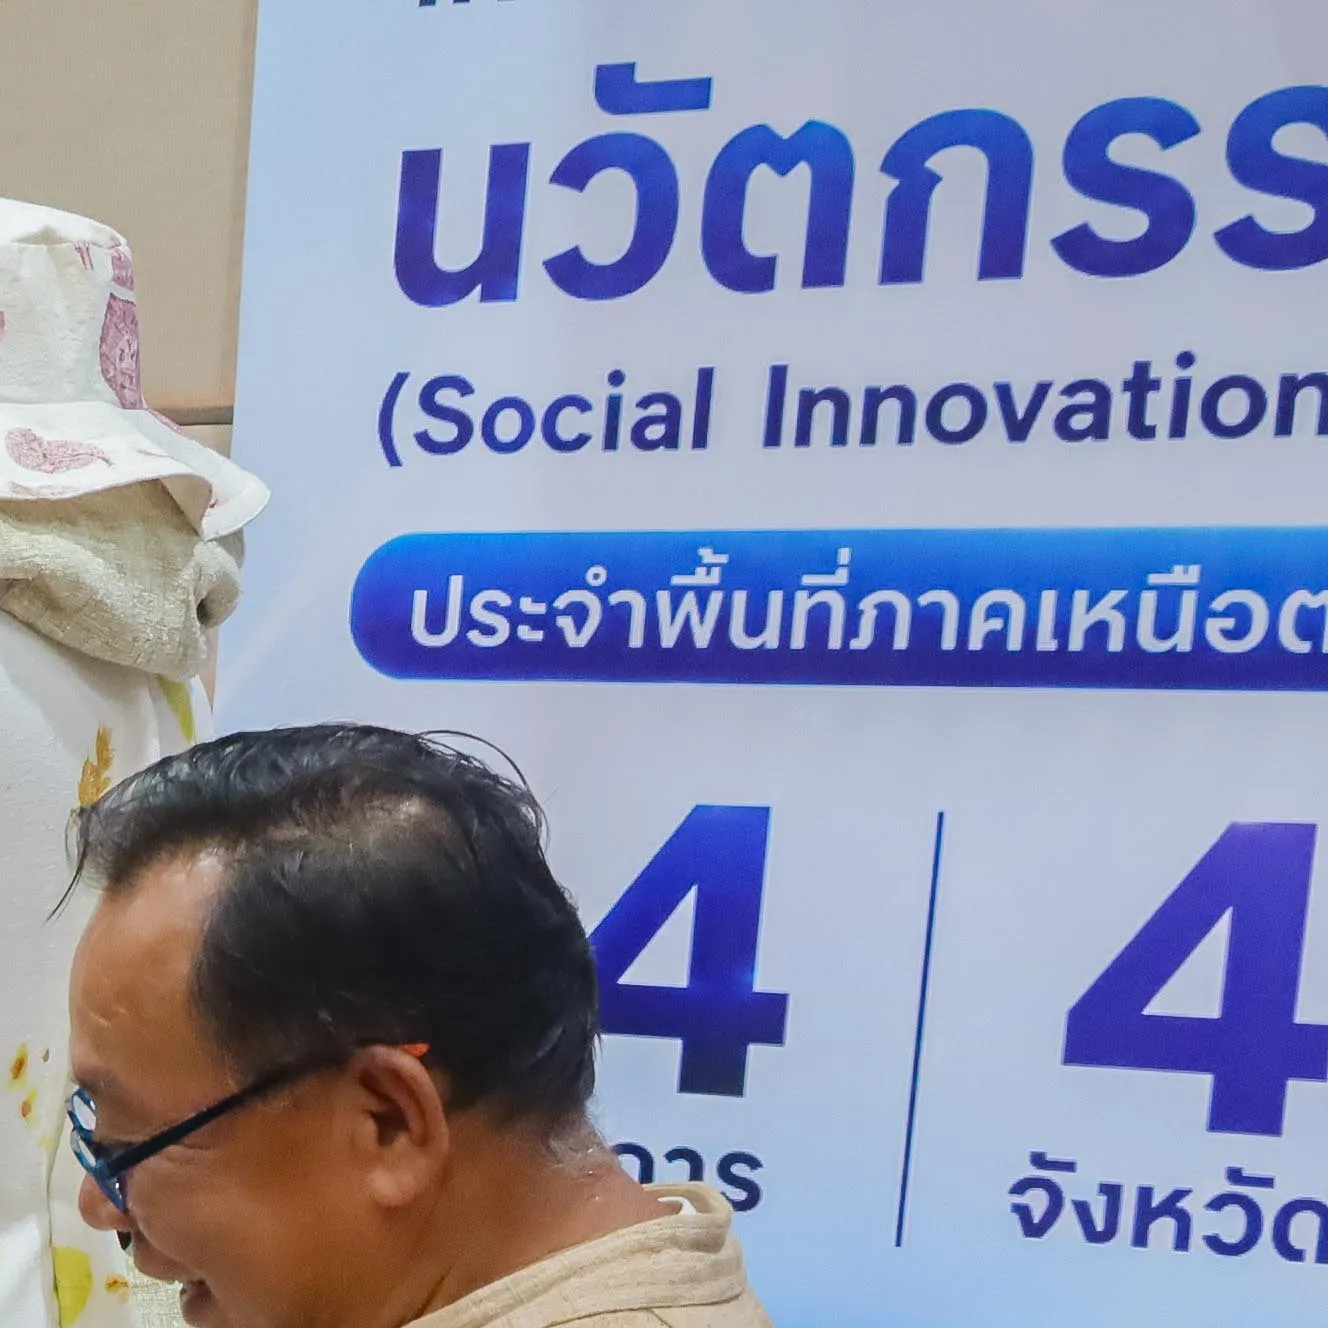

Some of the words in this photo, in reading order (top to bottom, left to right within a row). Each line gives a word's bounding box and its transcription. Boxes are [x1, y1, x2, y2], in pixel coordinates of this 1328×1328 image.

[394, 62, 1328, 307] นวัตกรร
[378, 367, 714, 467] (Social
[762, 350, 1328, 450] Innovation
[586, 803, 790, 1098] 4
[1061, 821, 1328, 1137] 4
[1007, 1150, 1328, 1265] จังหวัด
